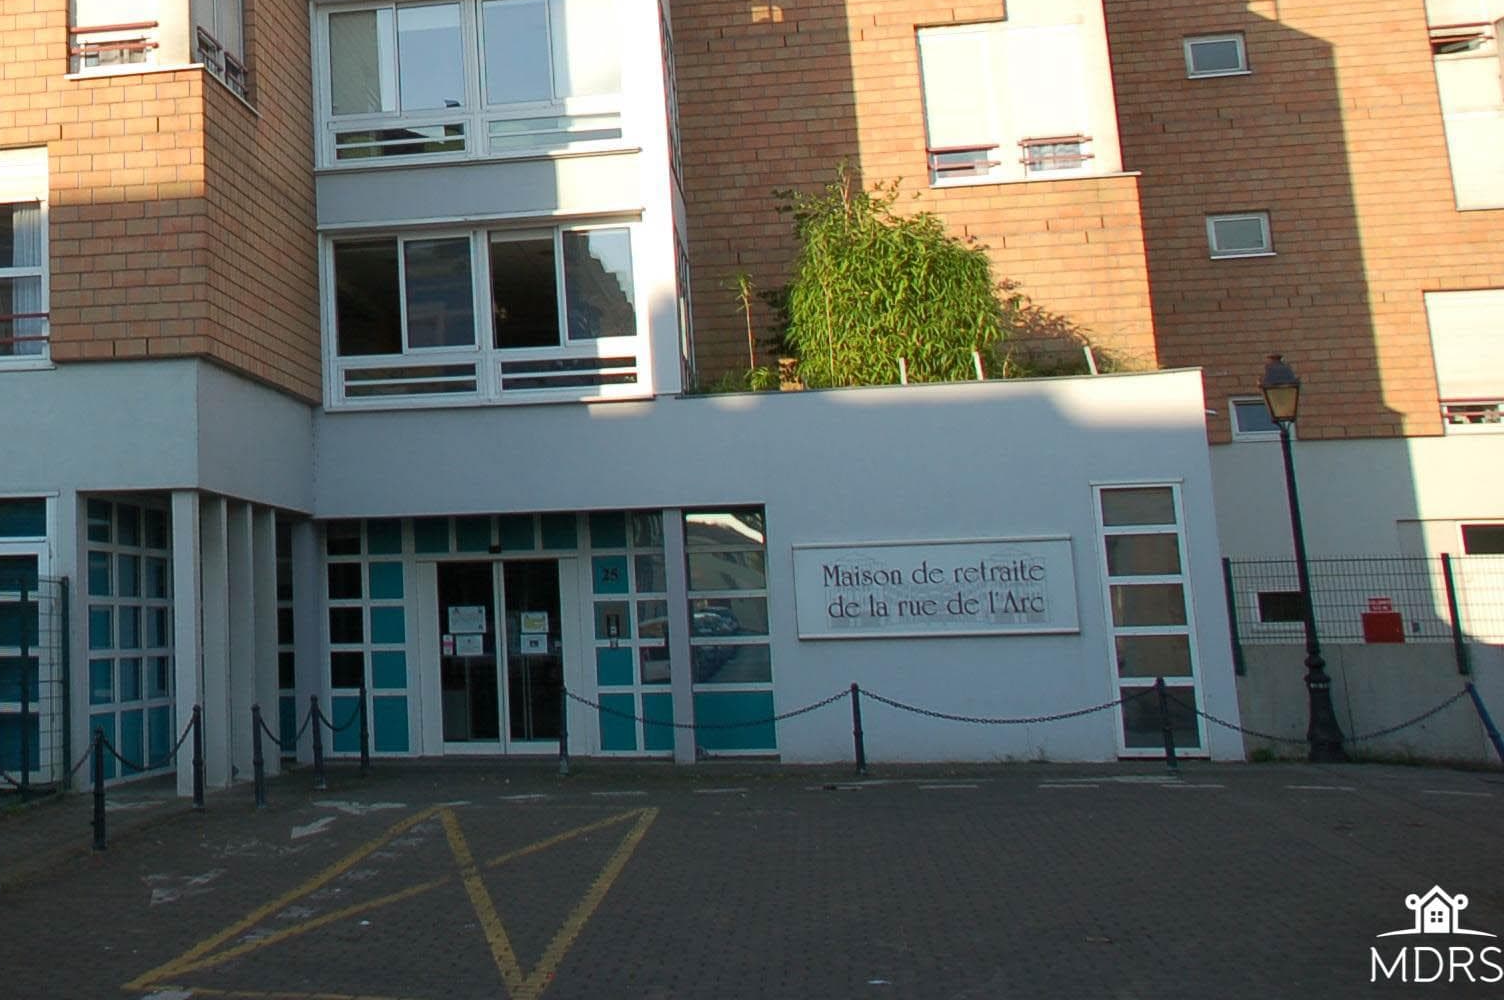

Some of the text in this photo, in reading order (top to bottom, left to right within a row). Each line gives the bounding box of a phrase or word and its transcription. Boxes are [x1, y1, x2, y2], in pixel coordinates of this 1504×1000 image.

[601, 567, 618, 582] 25
[822, 560, 1045, 588] Maison de retraite
[827, 590, 1046, 619] de la rue de l'Arc
